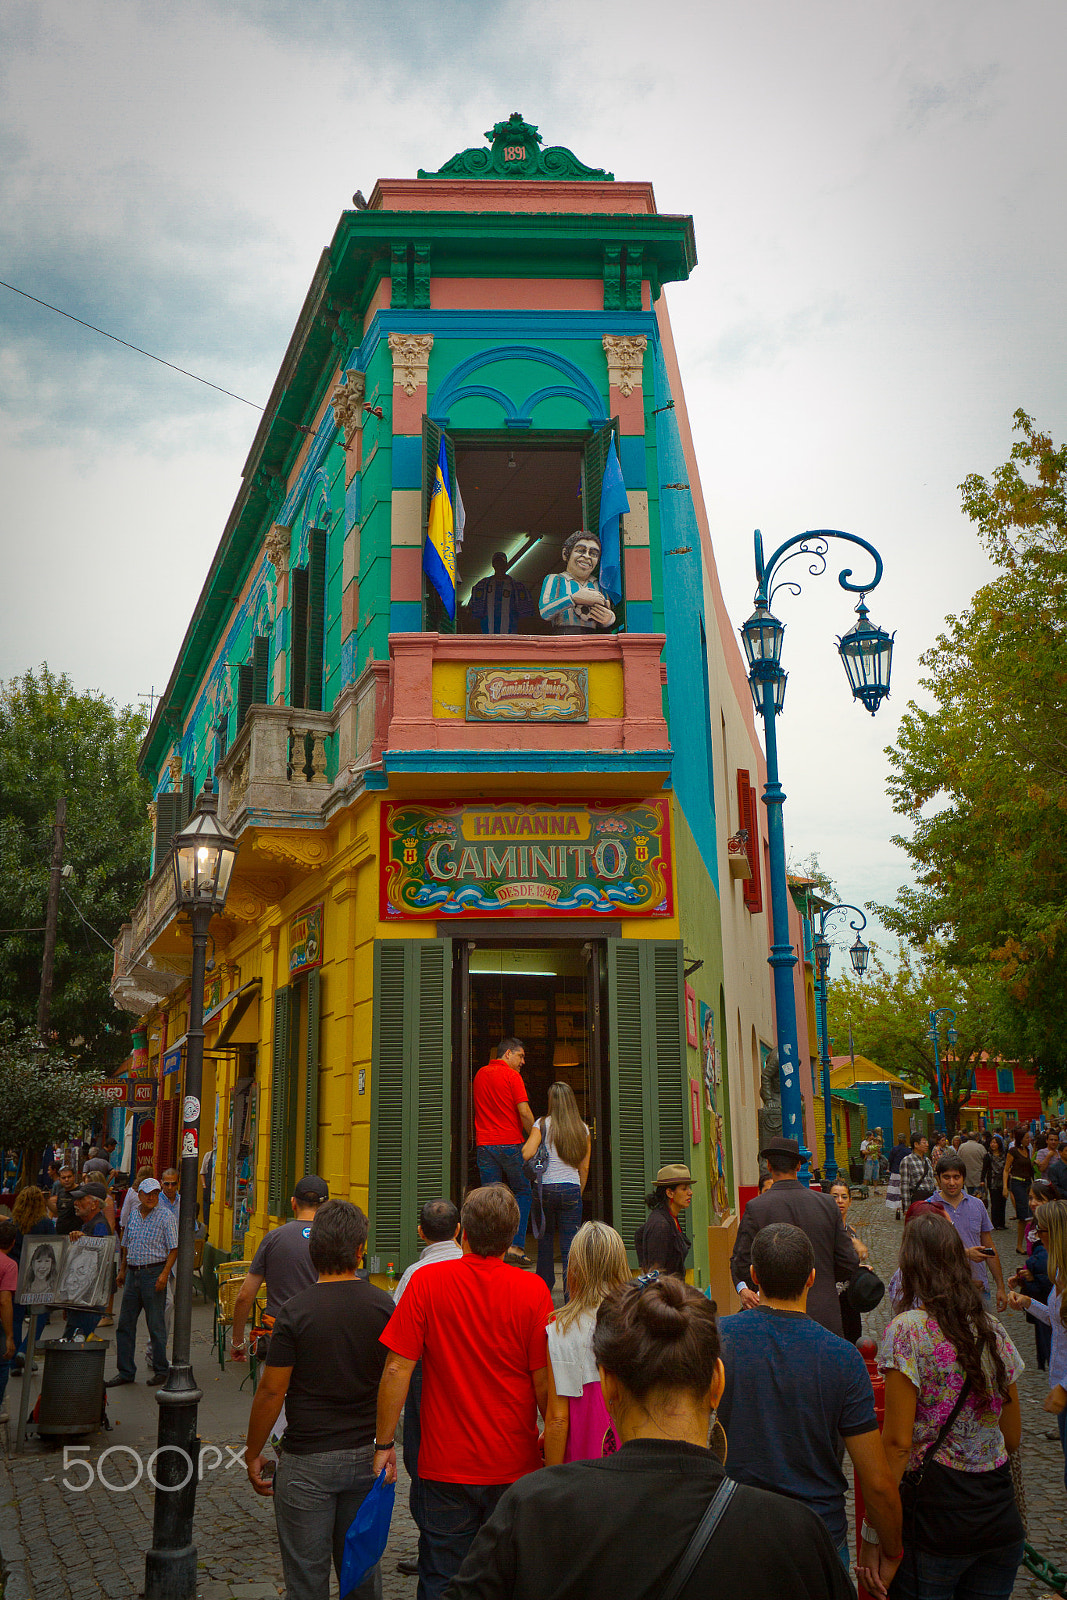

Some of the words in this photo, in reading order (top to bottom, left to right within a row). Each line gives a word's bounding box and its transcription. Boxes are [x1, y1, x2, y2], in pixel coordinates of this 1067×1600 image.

[503, 146, 526, 161] 1891
[474, 815, 581, 836] HAVANNA
[405, 850, 415, 862] H
[427, 839, 628, 881] CAMINITO
[637, 848, 647, 860] H
[498, 884, 535, 900] DESDE
[536, 885, 559, 901] 1948
